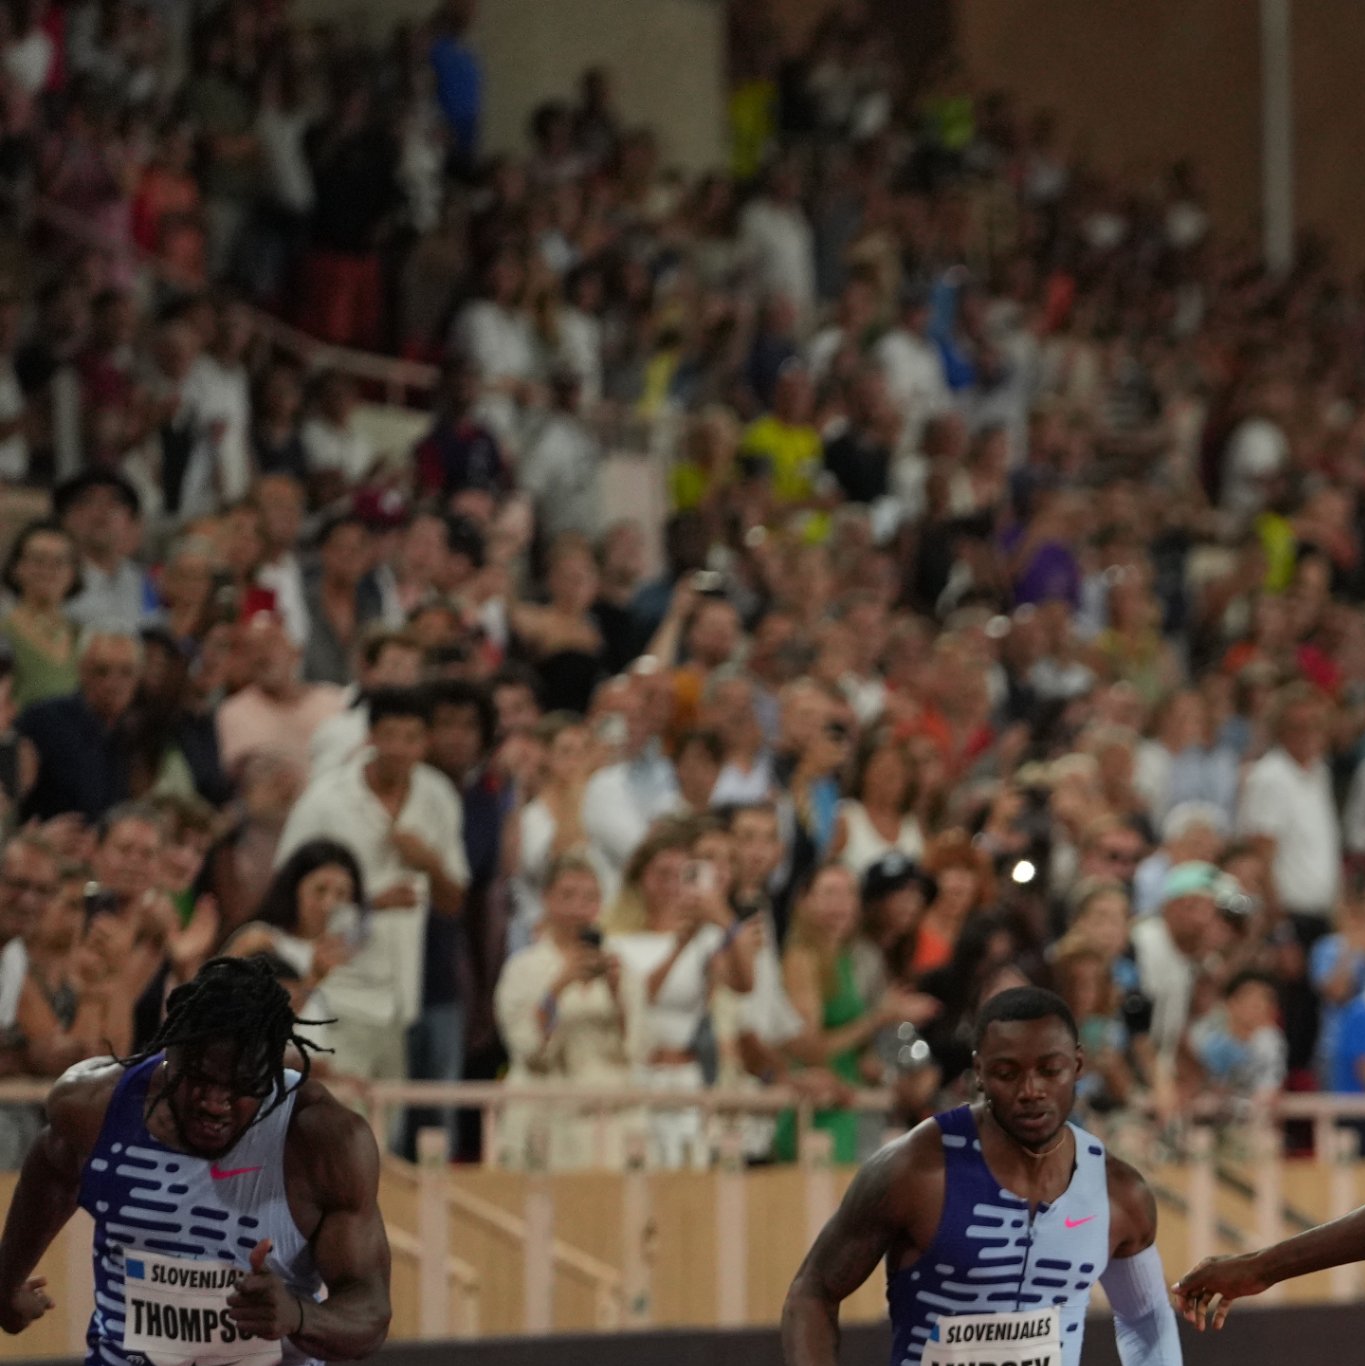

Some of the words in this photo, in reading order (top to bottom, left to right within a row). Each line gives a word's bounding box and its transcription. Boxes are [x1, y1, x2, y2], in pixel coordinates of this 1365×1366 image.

[151, 1263, 245, 1289] SLOVENIJA
[130, 1299, 263, 1343] THOMPS
[947, 1317, 1052, 1344] SLOVENIJALES
